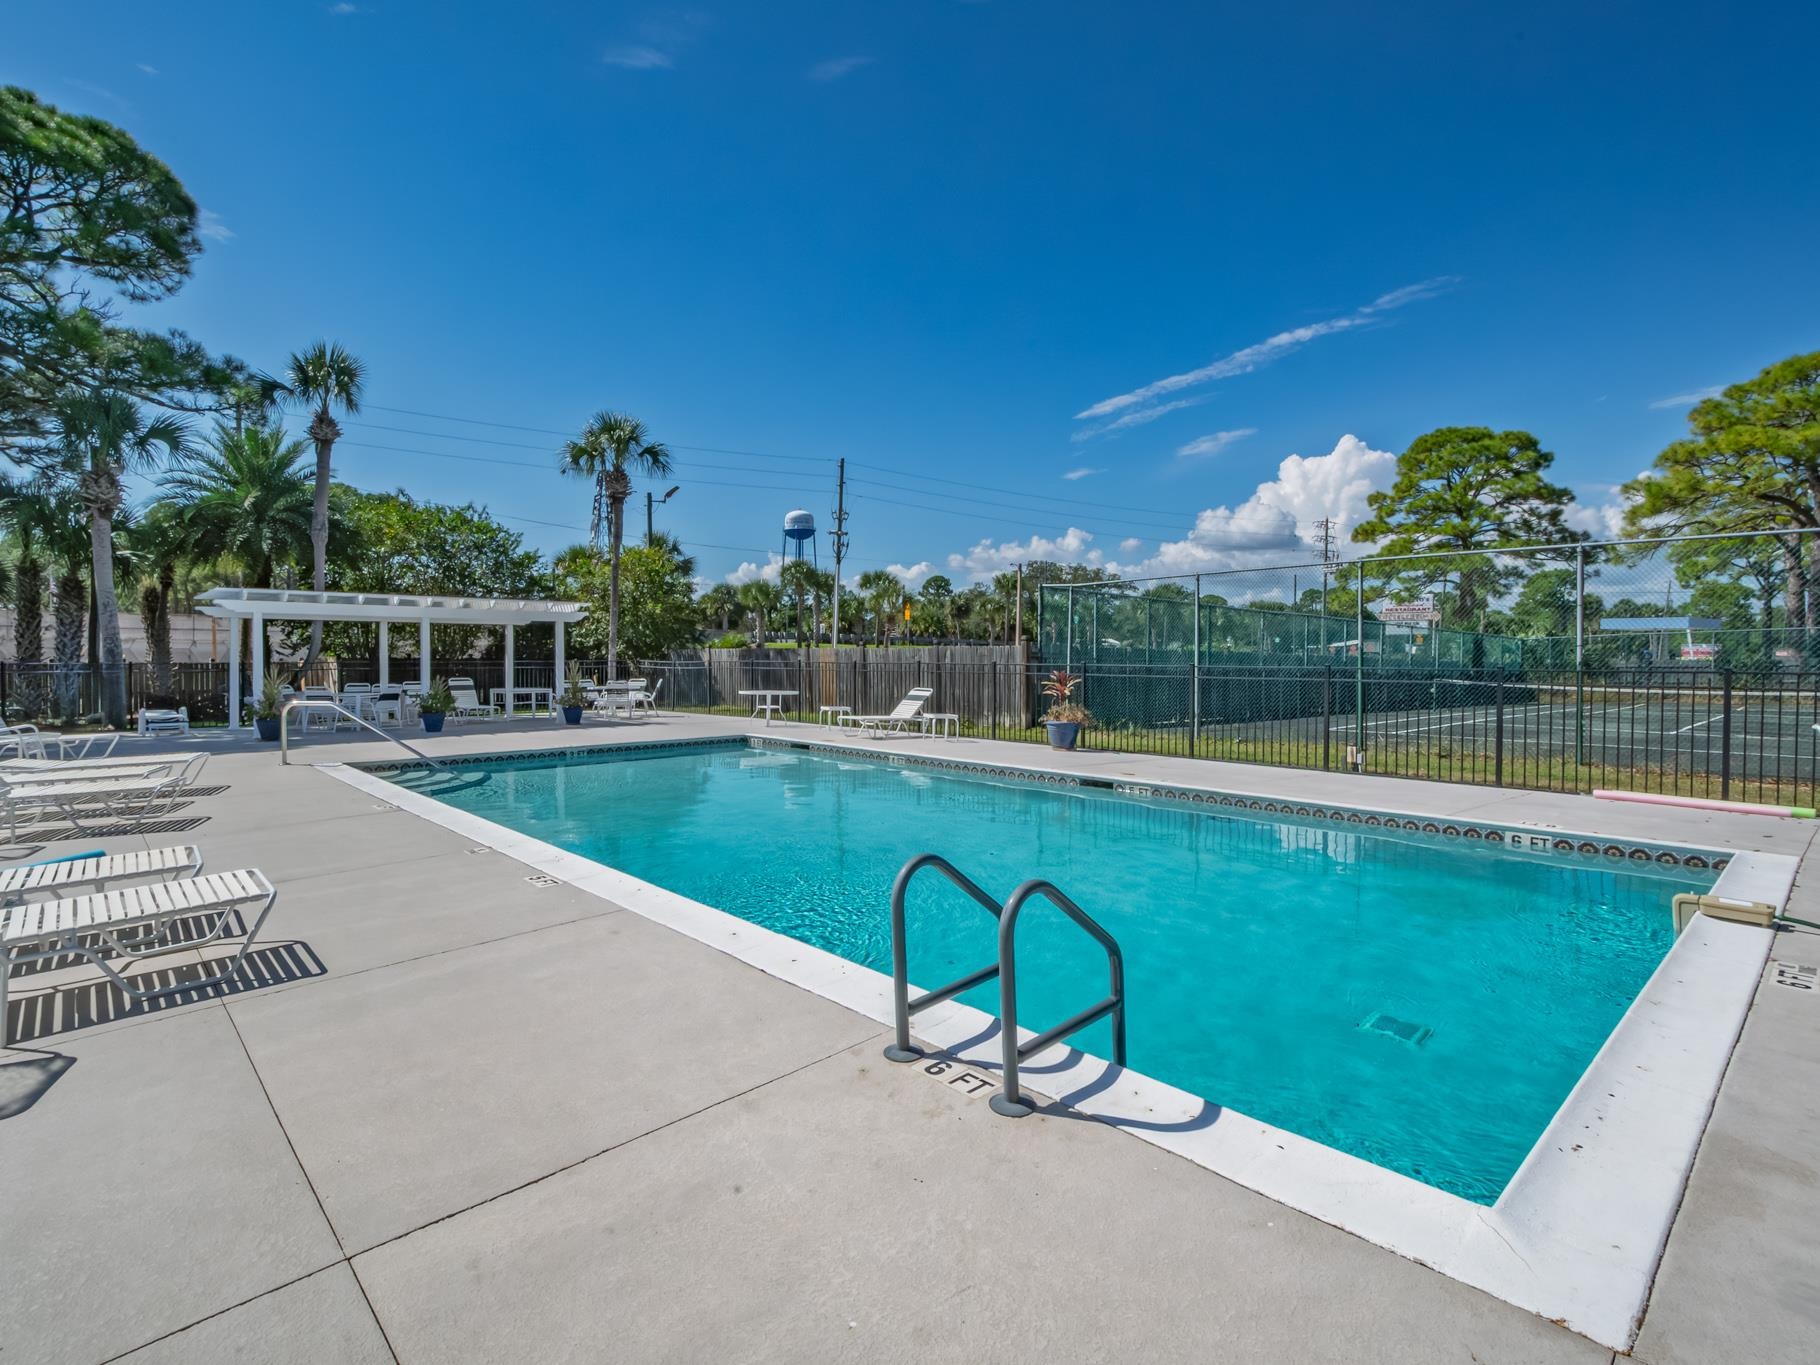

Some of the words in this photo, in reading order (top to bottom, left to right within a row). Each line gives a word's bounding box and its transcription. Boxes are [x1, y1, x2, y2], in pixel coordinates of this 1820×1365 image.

[1511, 834, 1522, 845] 6
[1530, 836, 1550, 848] FT
[1776, 980, 1812, 989] 6
[924, 1060, 953, 1076] 6
[948, 1072, 995, 1094] FT
